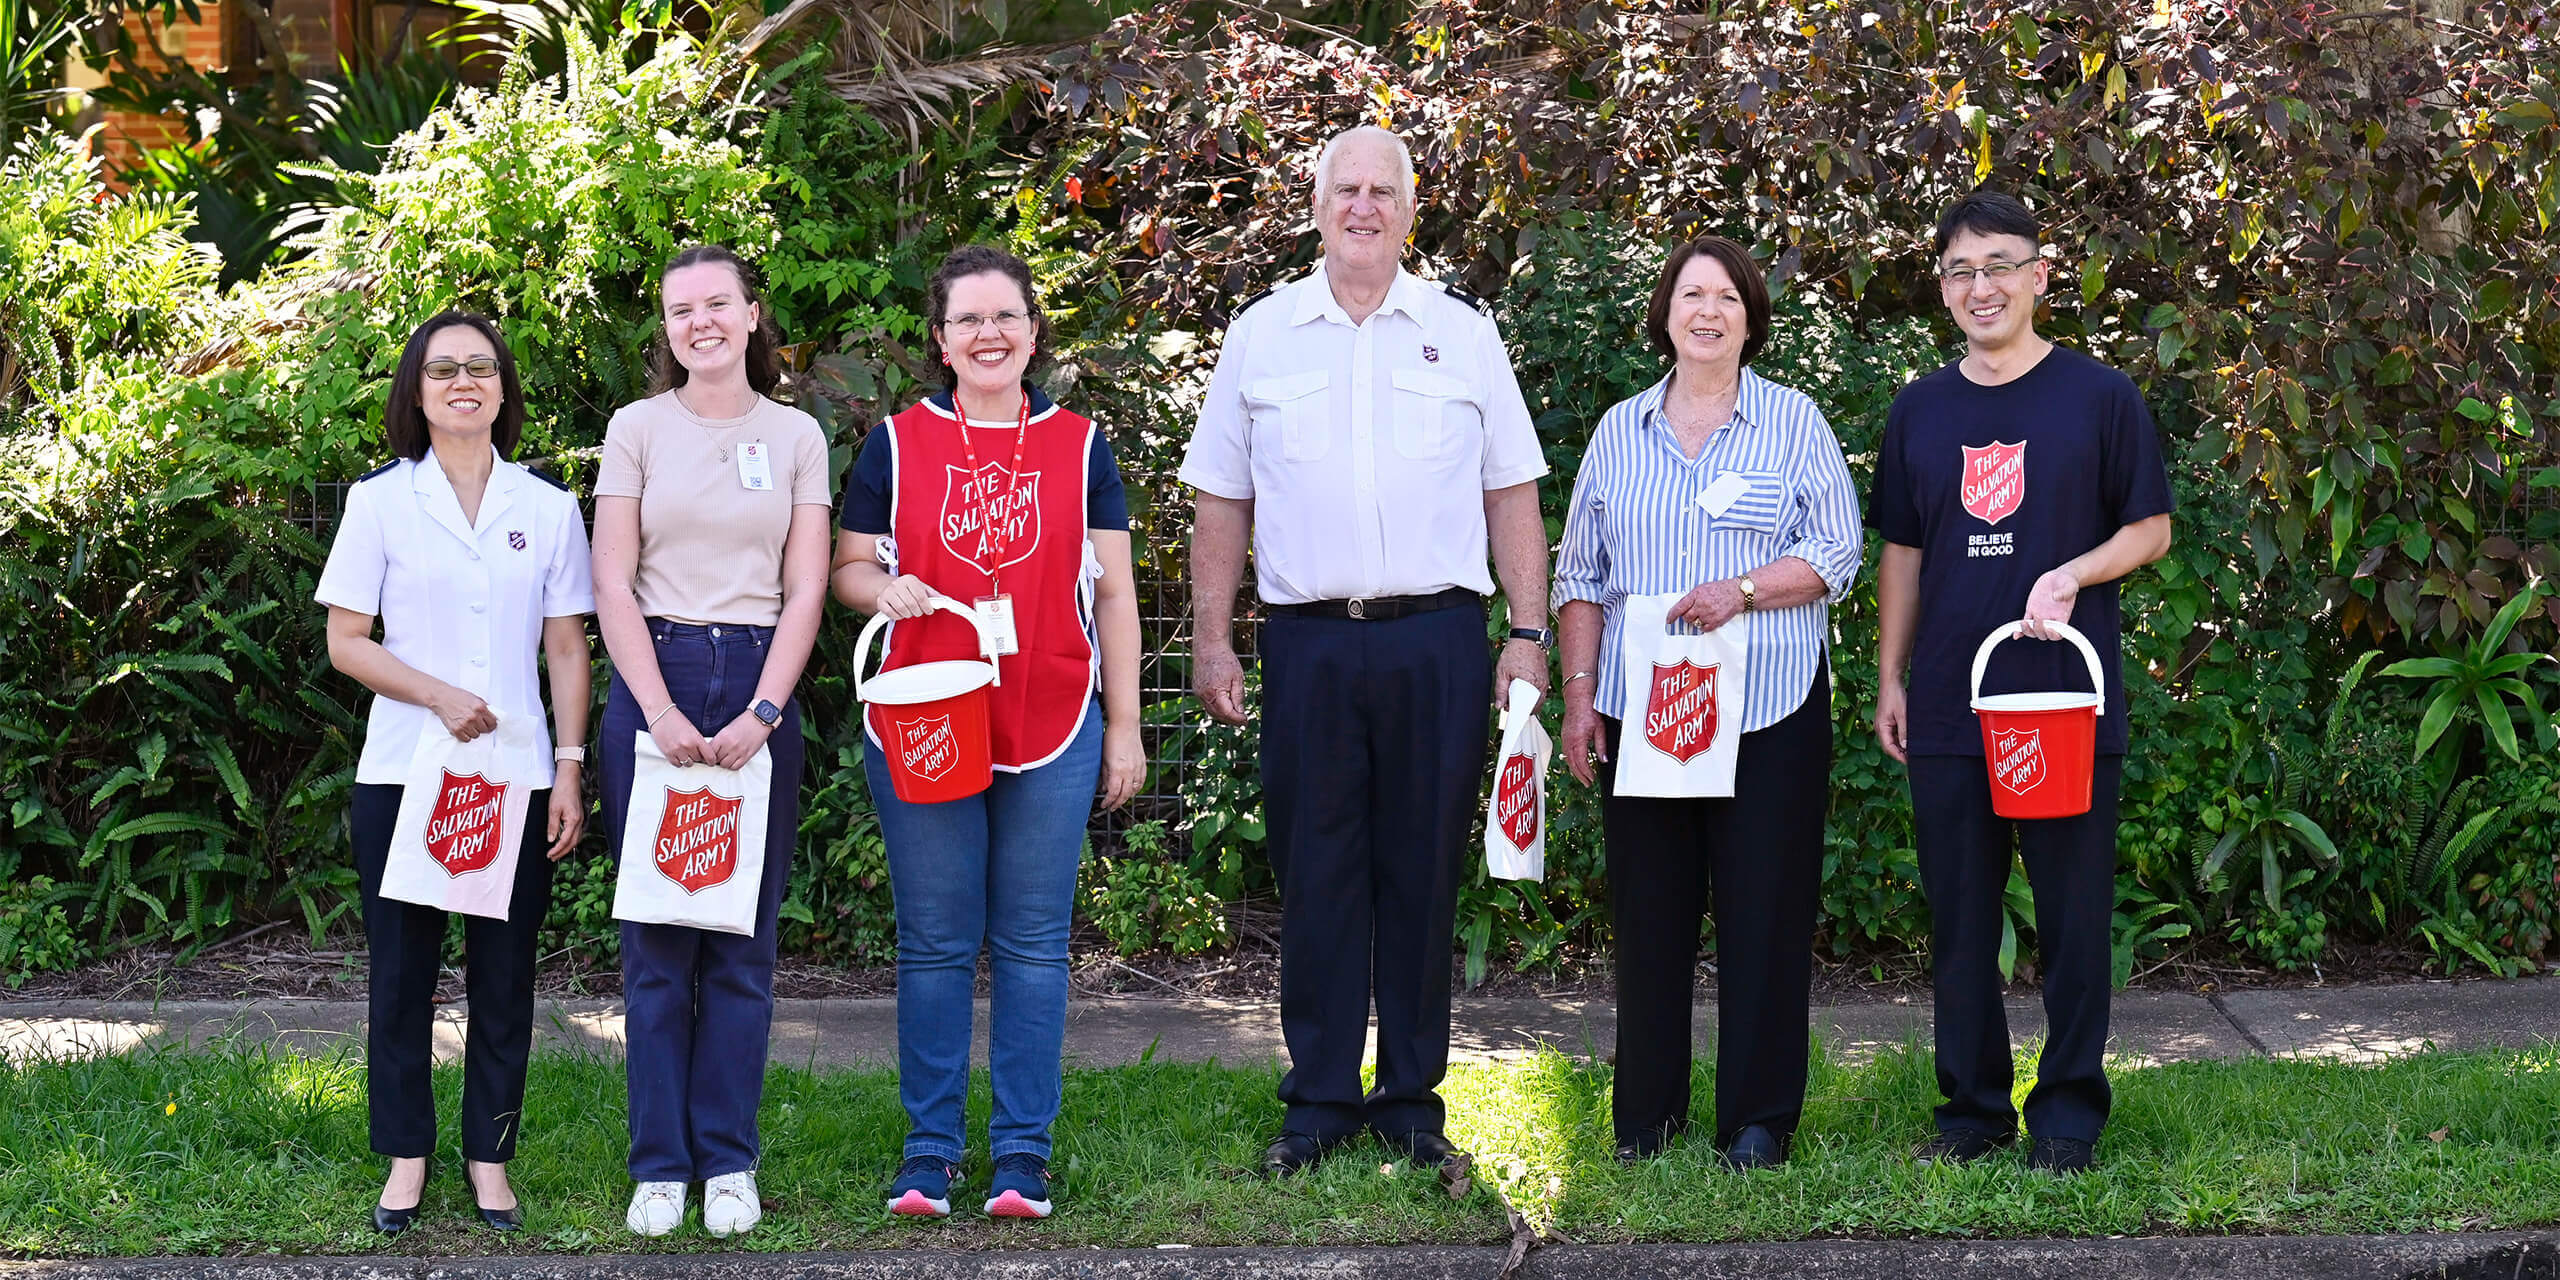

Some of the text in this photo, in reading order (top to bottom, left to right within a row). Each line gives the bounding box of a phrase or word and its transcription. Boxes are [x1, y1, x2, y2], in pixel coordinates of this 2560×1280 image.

[1966, 449, 2021, 506] SALVATION
[1974, 447, 2000, 476] THE
[945, 481, 1032, 541] SALATON
[1986, 474, 2018, 517] ARMY
[1967, 544, 2014, 557] IN GOOD
[1968, 532, 2013, 546] BELIEVE
[1661, 667, 1690, 701] THE
[1647, 673, 1714, 736] SALVATION
[904, 720, 949, 767] SALVATION
[907, 721, 928, 745] THE
[1999, 733, 2018, 755] THE
[924, 740, 950, 775] ARMY
[1996, 735, 2038, 778] SALVATION
[2012, 755, 2037, 788] ARMY
[447, 782, 482, 810] THE
[675, 796, 710, 828] THE
[443, 822, 494, 863] ARMY
[656, 805, 737, 863] SALVATION
[680, 836, 732, 881] ARMY
